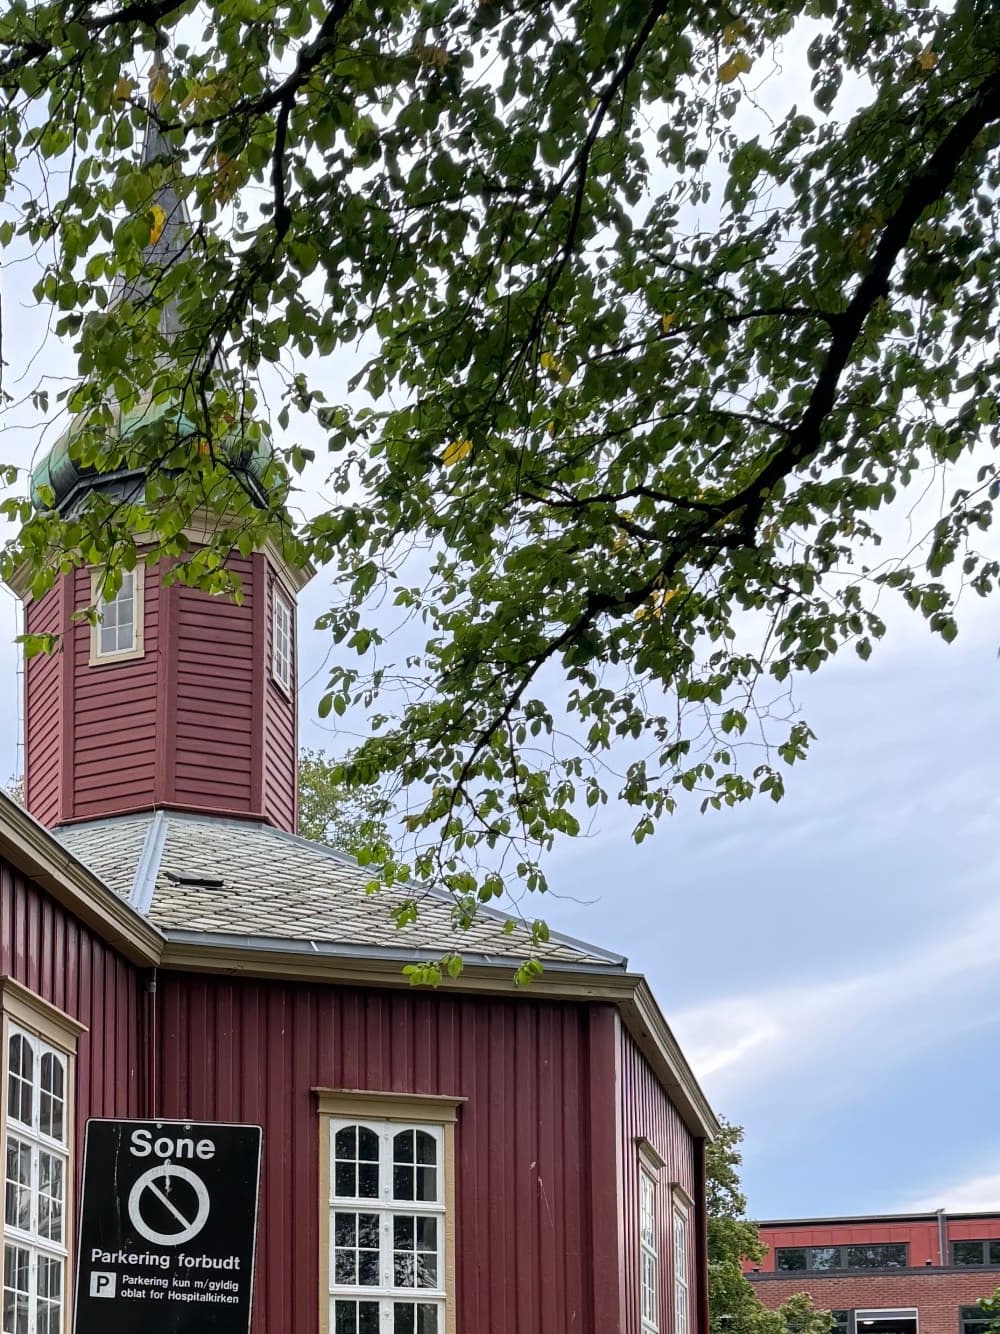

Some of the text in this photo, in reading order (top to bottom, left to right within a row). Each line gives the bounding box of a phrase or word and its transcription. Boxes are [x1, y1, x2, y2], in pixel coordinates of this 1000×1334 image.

[129, 1129, 216, 1160] Sone
[91, 1248, 241, 1270] Parkering forbudt
[96, 1275, 110, 1294] P
[122, 1275, 239, 1292] Parkering kun m/gyldig
[121, 1288, 239, 1303] oblat for Hospitalkirken
